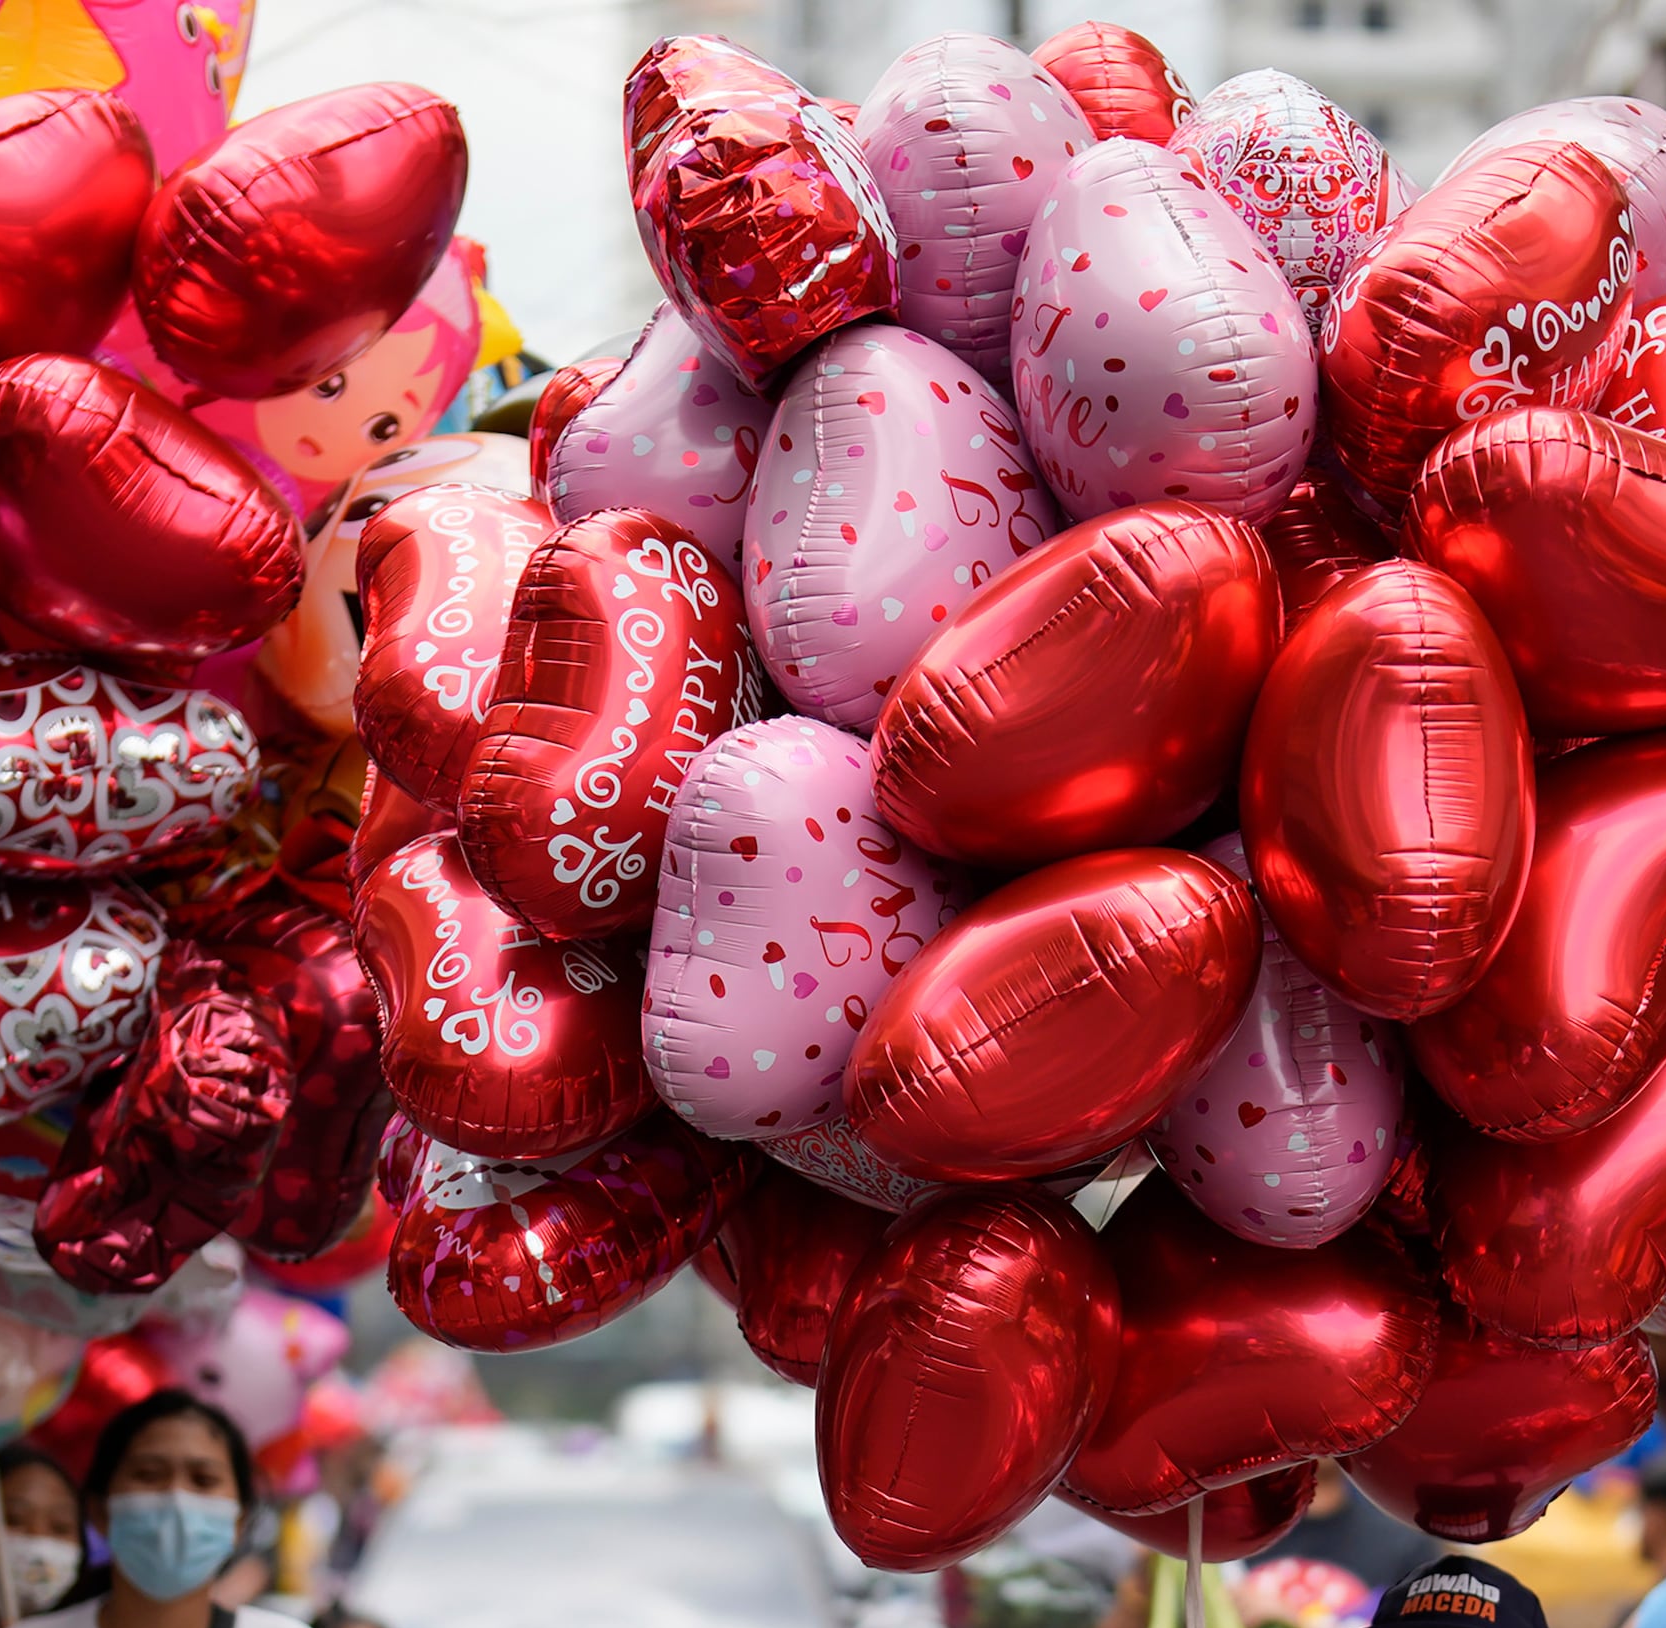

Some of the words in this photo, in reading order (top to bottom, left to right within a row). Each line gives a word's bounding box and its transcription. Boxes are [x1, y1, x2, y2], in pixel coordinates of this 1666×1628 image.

[644, 637, 722, 815] HAPPY
[1406, 1573, 1501, 1604] EDWARD
[1399, 1592, 1497, 1623] MACEDA
